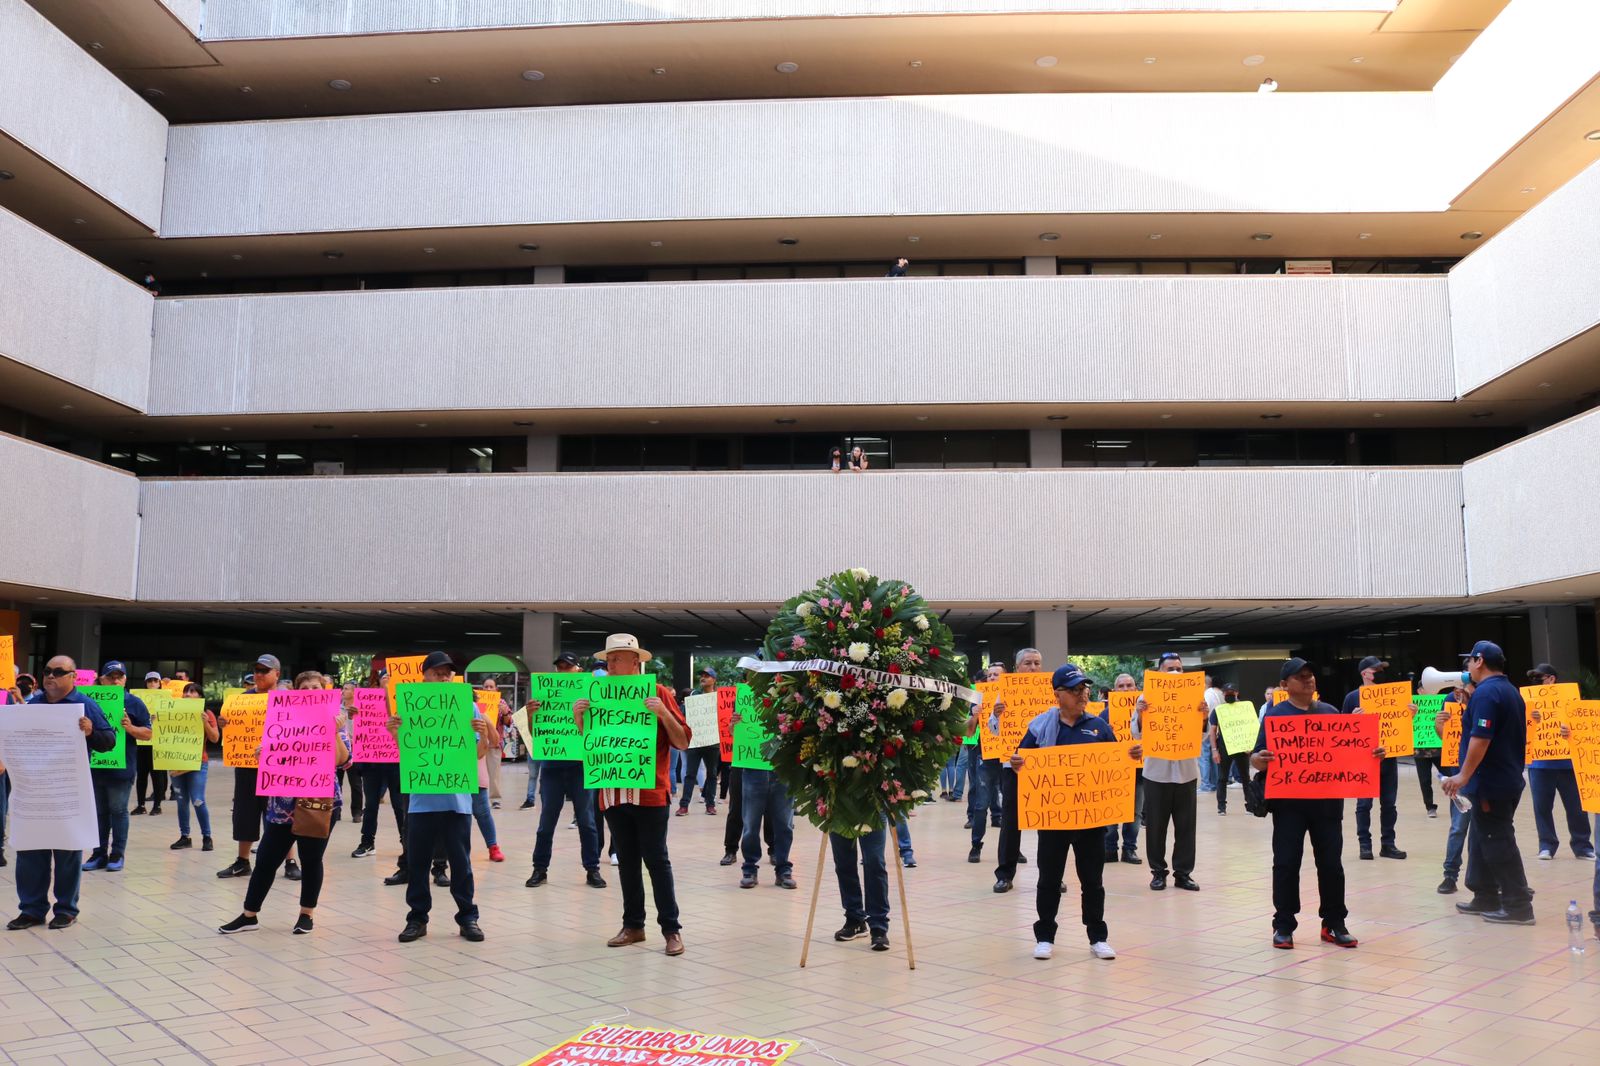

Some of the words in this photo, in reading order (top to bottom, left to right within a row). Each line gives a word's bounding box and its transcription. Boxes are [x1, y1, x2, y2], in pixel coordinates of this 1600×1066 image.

[537, 675, 583, 690] POLICIAS
[909, 676, 926, 689] EN
[1004, 675, 1030, 687] TERE
[1149, 676, 1201, 690] TRANSITOS
[547, 689, 562, 699] DE
[589, 681, 650, 702] CULIACAN
[1163, 691, 1179, 702] DE
[1361, 685, 1407, 700] QUIERO
[1527, 686, 1559, 699] LOS
[160, 701, 175, 709] EN
[273, 694, 335, 708] MAZATLAN
[360, 702, 376, 710] LOS
[403, 691, 460, 712] ROCHA
[1014, 698, 1026, 707] LA
[1148, 702, 1193, 714] SINALOA
[1374, 698, 1398, 708] SER
[157, 710, 198, 722] ELOTA
[277, 711, 293, 722] EL
[588, 706, 652, 730] PRESENTE
[1003, 710, 1016, 718] DE
[1163, 716, 1177, 724] EN
[1542, 711, 1558, 721] DE
[409, 713, 458, 730] MOYA
[1149, 720, 1184, 732] BUSCA
[1270, 720, 1296, 733] LOS
[1304, 718, 1360, 735] POLICIAS
[1569, 721, 1588, 731] LOS
[159, 725, 198, 735] VIUDAS
[267, 724, 327, 740] QUIMICO
[1165, 732, 1177, 741] DE
[158, 737, 169, 745] DE
[270, 742, 289, 752] NO
[292, 741, 332, 752] QUIERE
[403, 733, 467, 750] CUMPLA
[583, 733, 649, 751] GUERREROS
[1151, 741, 1194, 753] JUSTICIA
[1273, 735, 1325, 750] TAMBIEN
[1330, 736, 1370, 748] SOMOS
[542, 747, 567, 757] VIDA
[266, 755, 318, 767] CUMPLIR
[417, 752, 444, 767] SU
[587, 753, 633, 767] UNIDOS
[639, 755, 652, 766] DE
[1024, 749, 1121, 771] QUEREMOS
[1278, 752, 1333, 768] PUEBLO
[261, 771, 307, 791] DECRETO
[310, 773, 332, 788] 645
[409, 771, 470, 790] PALABRA
[589, 767, 646, 785] SINALOA
[1028, 773, 1087, 790] VALER
[1091, 767, 1131, 785] VIVOS
[1298, 769, 1370, 784] GOBERNADOR
[1023, 792, 1031, 808] Y
[1041, 790, 1066, 807] NO
[1073, 783, 1131, 806] MUERTOS
[1025, 802, 1124, 828] DIPUTADOS
[578, 1025, 706, 1051] GUERREROS
[700, 1035, 791, 1058] UNIDOS
